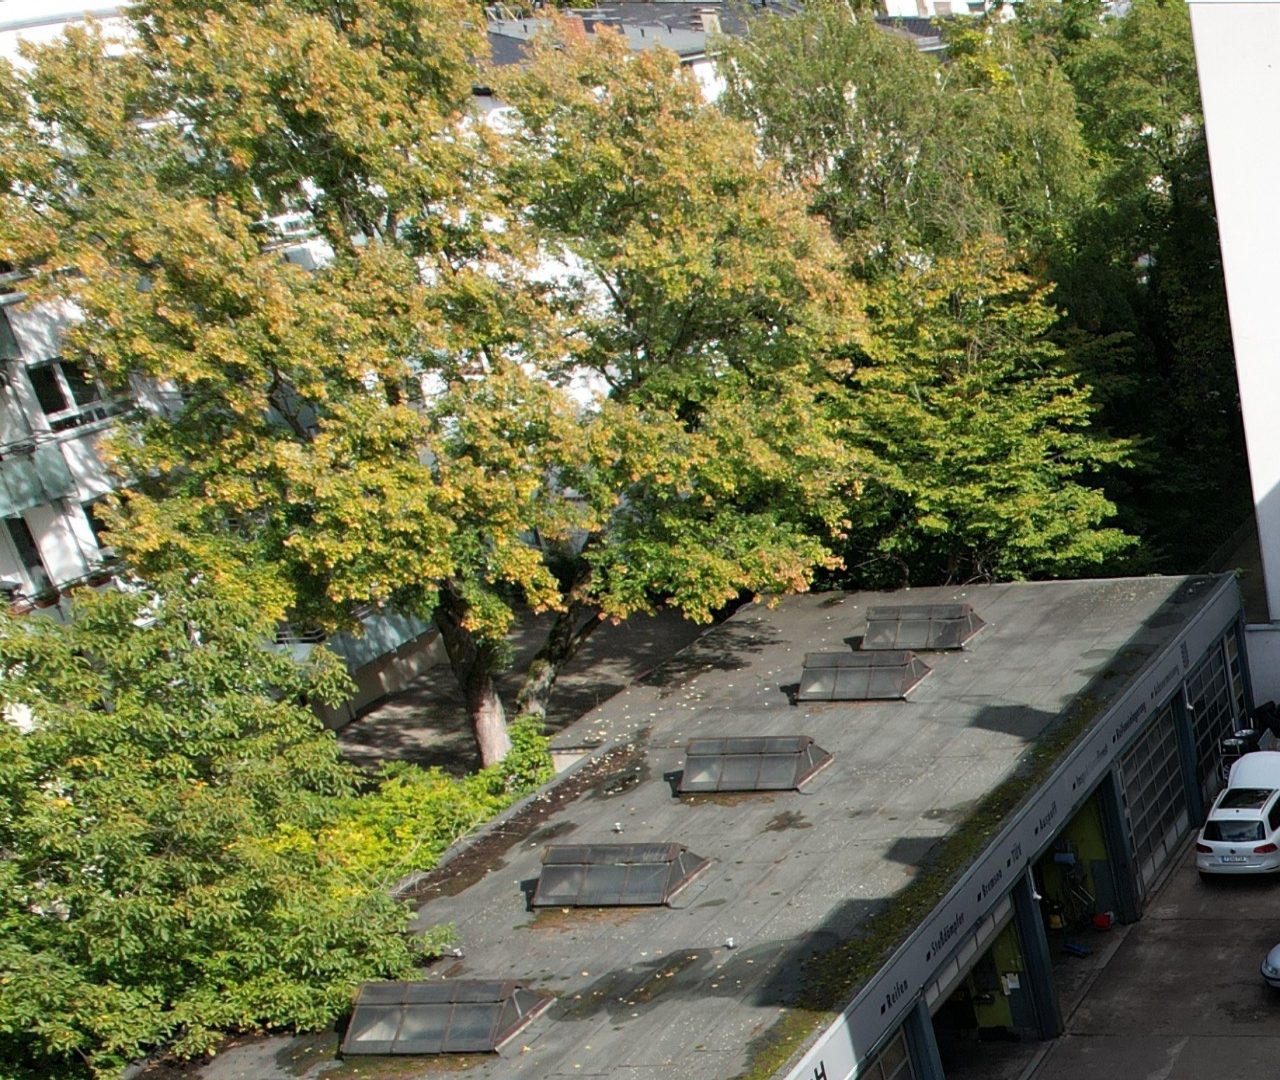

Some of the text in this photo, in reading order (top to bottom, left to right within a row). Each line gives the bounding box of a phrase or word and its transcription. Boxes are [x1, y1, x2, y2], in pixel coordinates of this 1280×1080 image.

[981, 869, 1003, 898] Bremsen
[931, 911, 965, 956] Stoßdämpfer
[886, 978, 909, 1010] Reifen
